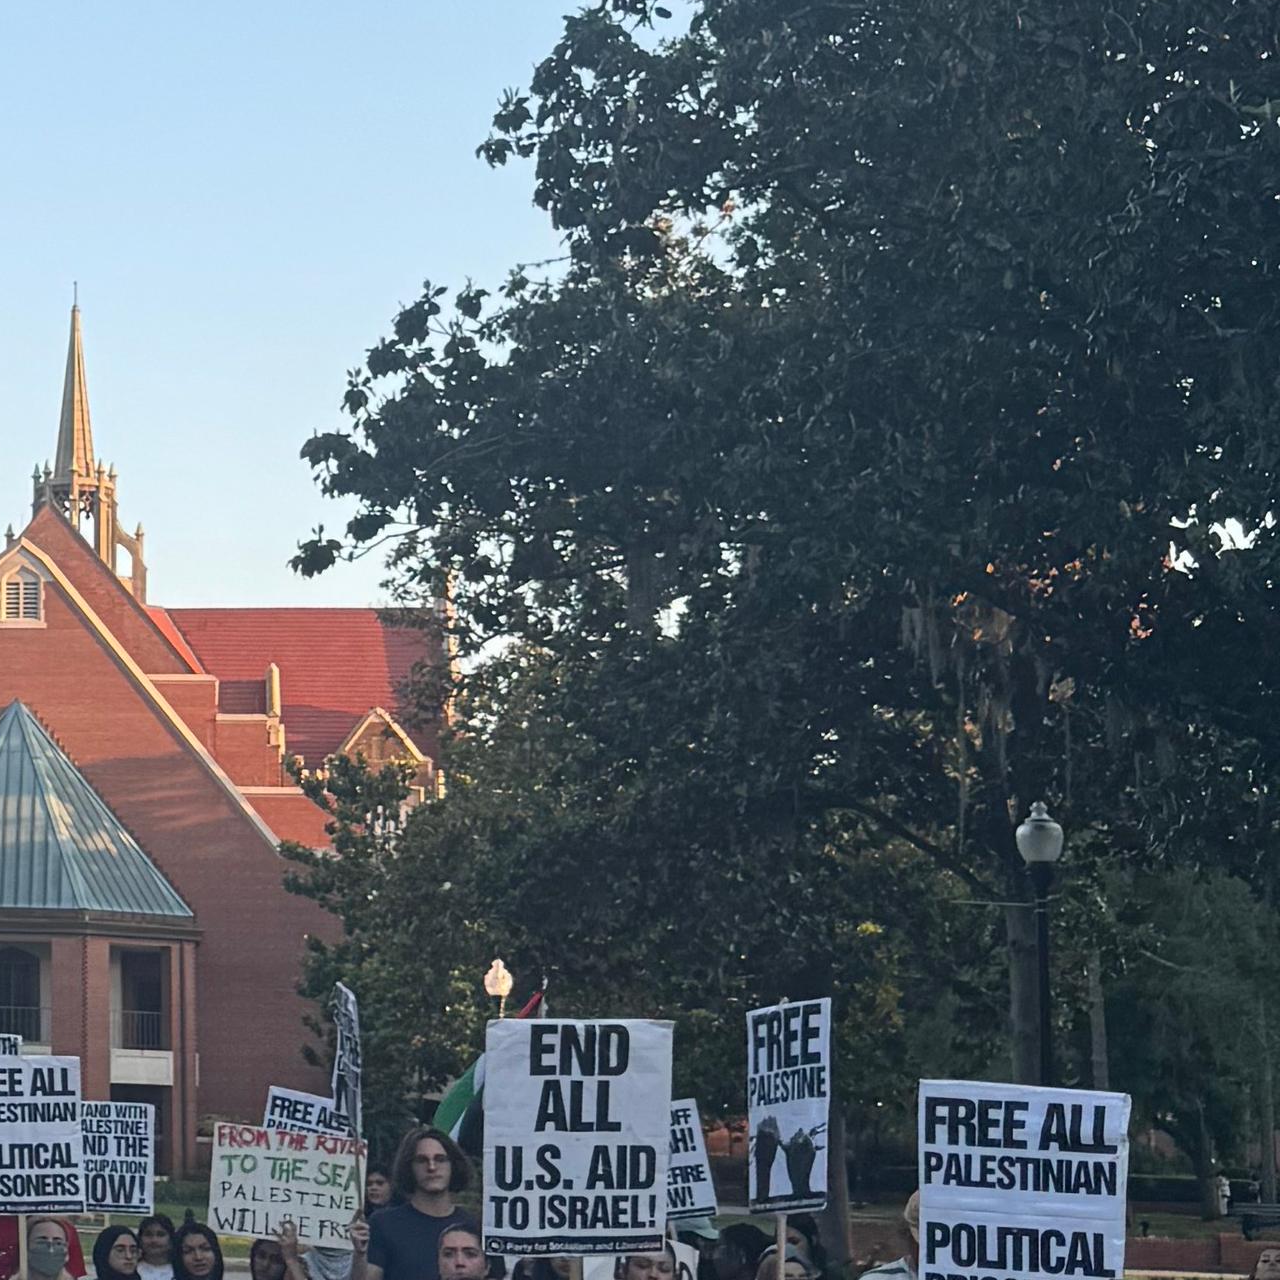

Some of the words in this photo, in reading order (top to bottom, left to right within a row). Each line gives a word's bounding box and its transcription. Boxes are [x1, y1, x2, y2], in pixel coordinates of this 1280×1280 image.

[529, 1024, 630, 1077] END
[752, 1003, 821, 1074] FREE
[30, 1068, 76, 1096] ALL
[750, 1067, 826, 1107] PALESTINE
[115, 1104, 147, 1119] WITH
[269, 1096, 314, 1123] FREE
[534, 1079, 622, 1132] ALL
[81, 1119, 148, 1135] ALESTINE!
[218, 1125, 271, 1151] FROM
[276, 1131, 308, 1152] THE
[924, 1096, 1029, 1150] FREE
[1038, 1103, 1118, 1154] ALL
[82, 1136, 109, 1156] ND
[113, 1136, 149, 1158] THE
[83, 1160, 147, 1174] CUPATION
[220, 1154, 258, 1176] TO
[264, 1156, 310, 1183] THE
[314, 1162, 358, 1192] SEA
[494, 1143, 573, 1191] U.S.
[586, 1145, 657, 1190] AID
[924, 1151, 1116, 1196] PALESTINIAN
[221, 1182, 355, 1210] PALESTINE
[490, 1195, 529, 1231] TO
[540, 1194, 657, 1230] ISRAEL!
[214, 1207, 275, 1236] WILL
[319, 1220, 352, 1240] FRE
[926, 1221, 1115, 1278] POLITICAL
